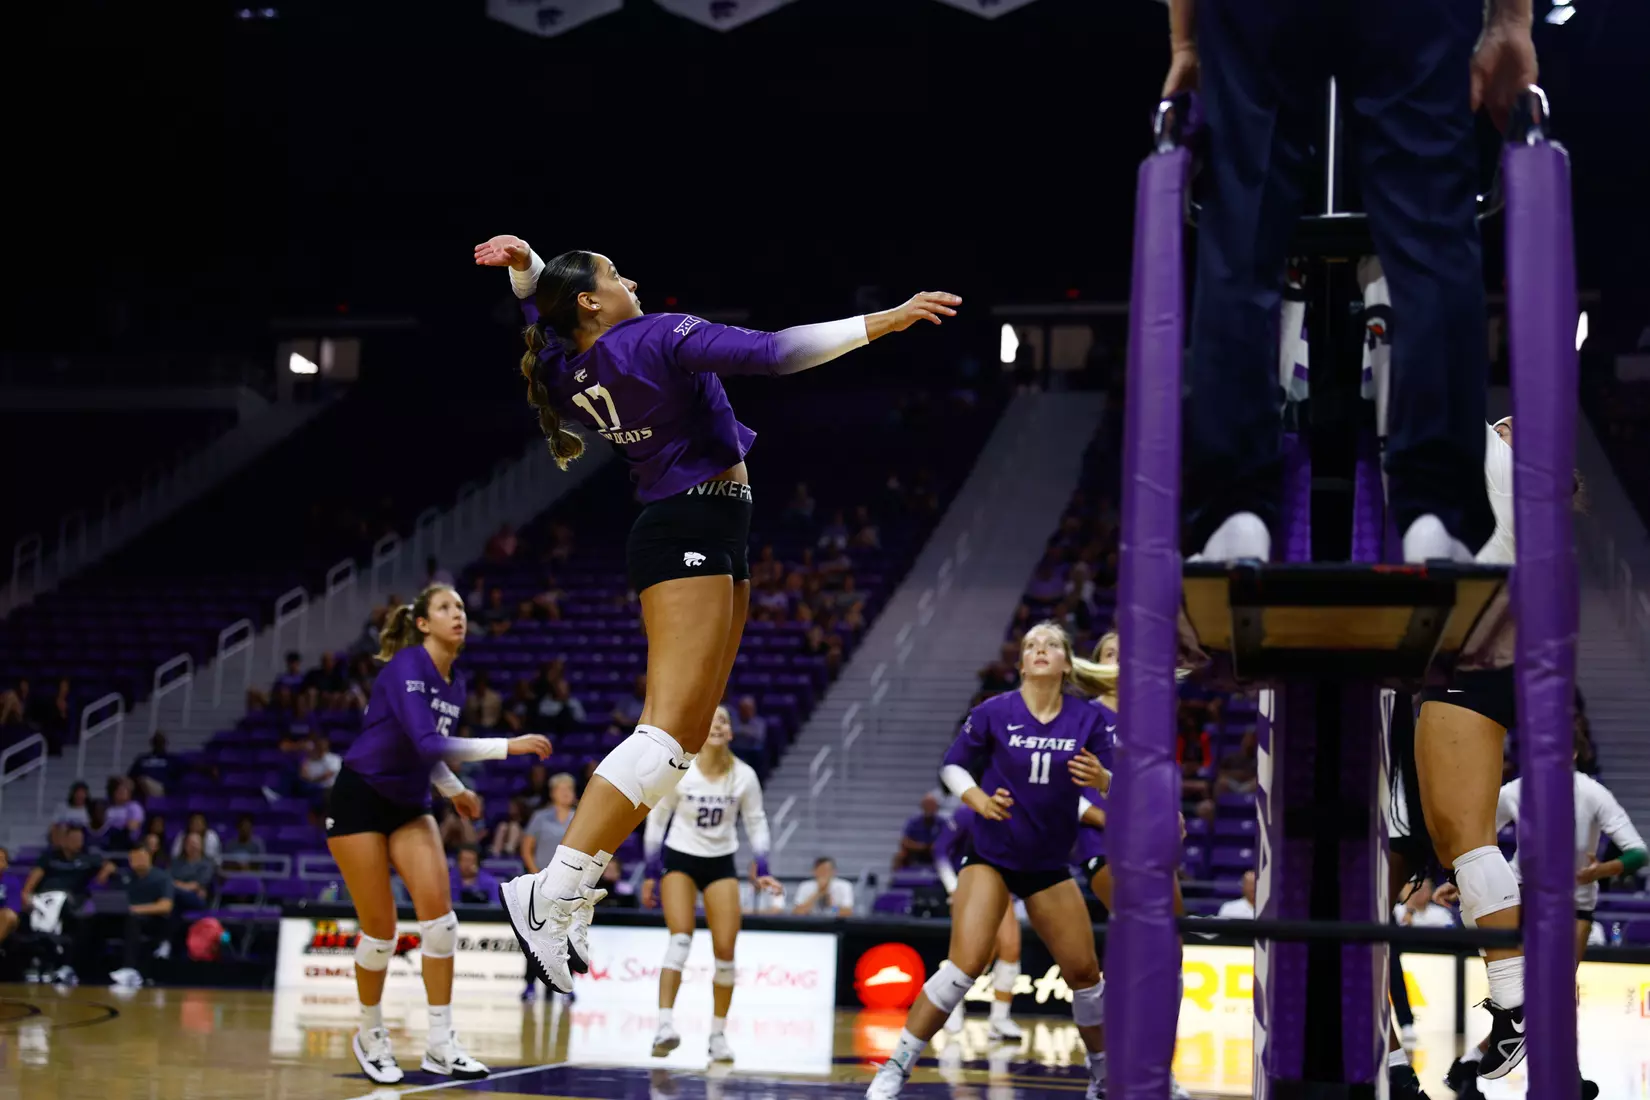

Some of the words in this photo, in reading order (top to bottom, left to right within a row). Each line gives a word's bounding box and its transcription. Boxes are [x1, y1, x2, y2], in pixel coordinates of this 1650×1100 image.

[571, 381, 621, 433] 17
[1008, 734, 1076, 752] K-STATE
[1028, 751, 1052, 785] 11
[697, 807, 724, 829] 20
